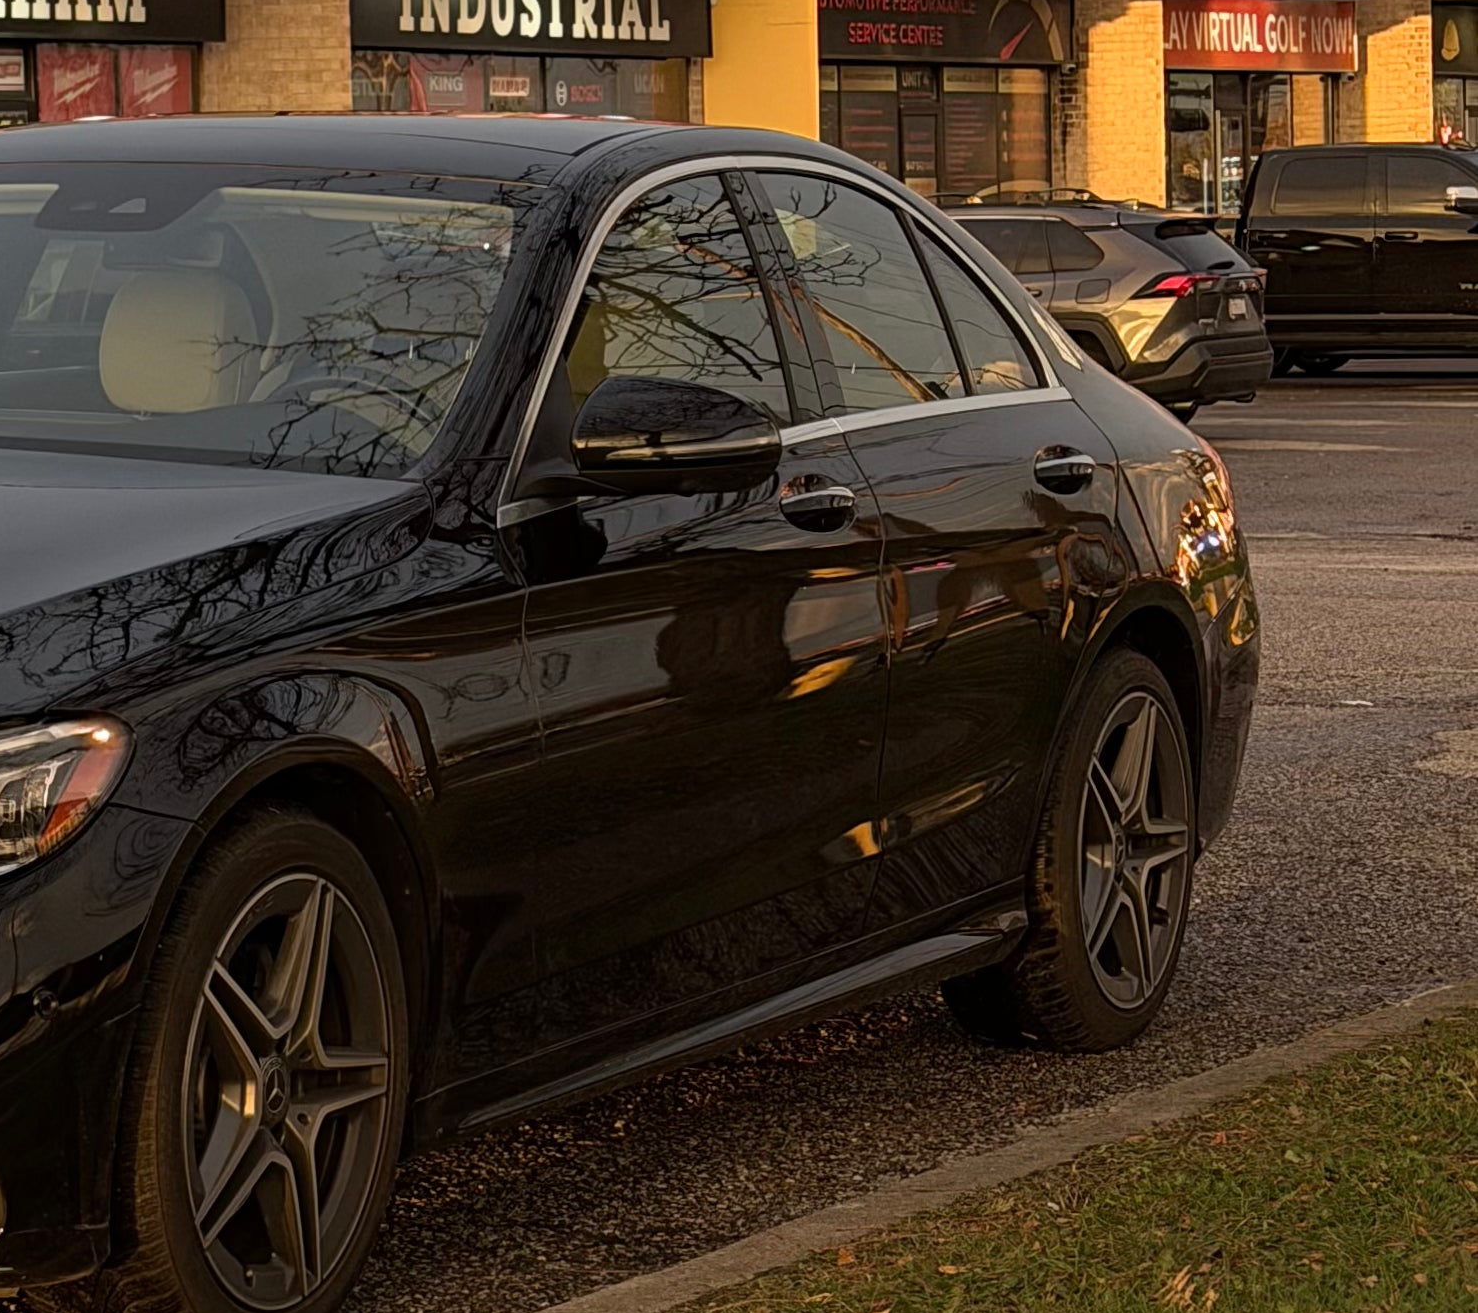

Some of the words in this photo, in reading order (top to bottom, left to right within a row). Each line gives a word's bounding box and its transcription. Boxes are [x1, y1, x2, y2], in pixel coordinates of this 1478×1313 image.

[848, 22, 897, 44] SERVICE
[899, 25, 943, 46] CENTRE
[1192, 11, 1263, 53] VIRTUAL
[1265, 13, 1307, 53] GOLF
[1310, 16, 1353, 54] NOW!
[429, 75, 463, 93] KING
